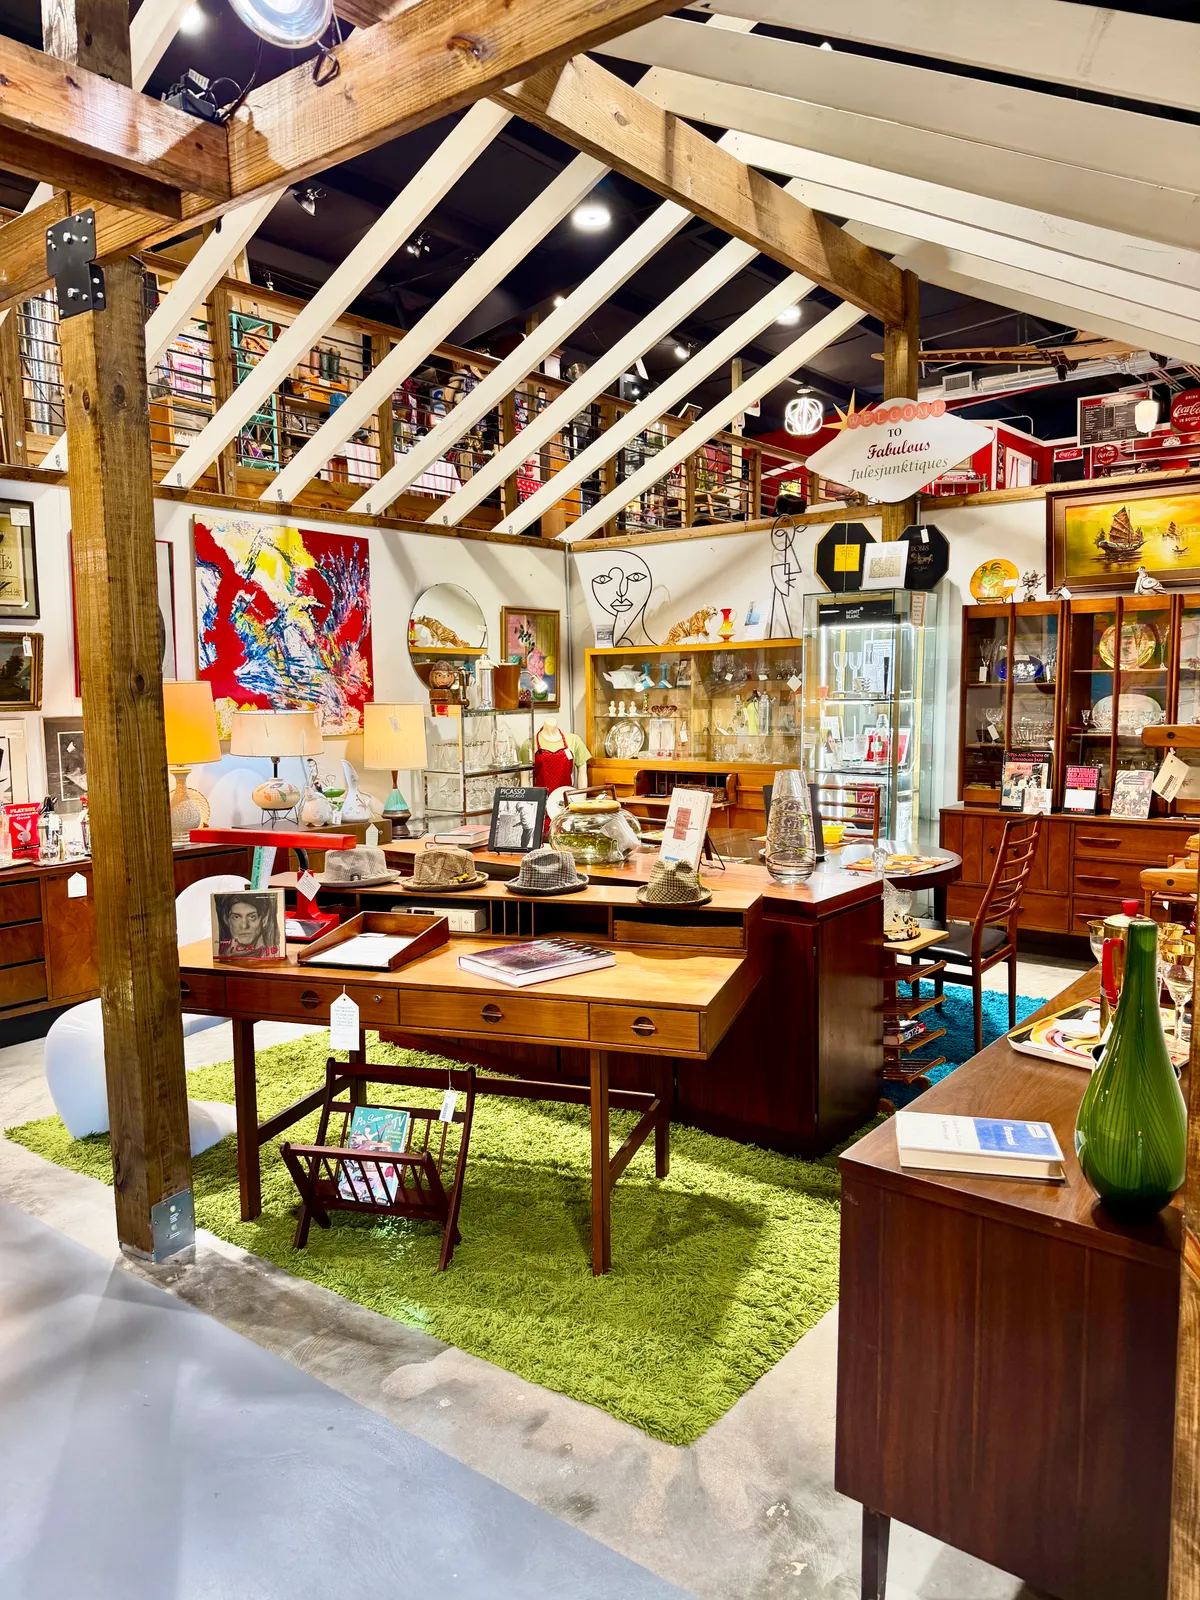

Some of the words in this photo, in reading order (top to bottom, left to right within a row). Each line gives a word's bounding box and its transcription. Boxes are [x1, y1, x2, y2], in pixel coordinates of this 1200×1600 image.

[849, 402, 943, 427] WELCOME
[887, 427, 902, 438] TO
[867, 440, 931, 460] Fabulous
[848, 457, 949, 483] Julesjunktiques
[910, 544, 930, 552] DOBBS
[366, 1113, 384, 1124] Seen
[391, 1114, 407, 1130] TV
